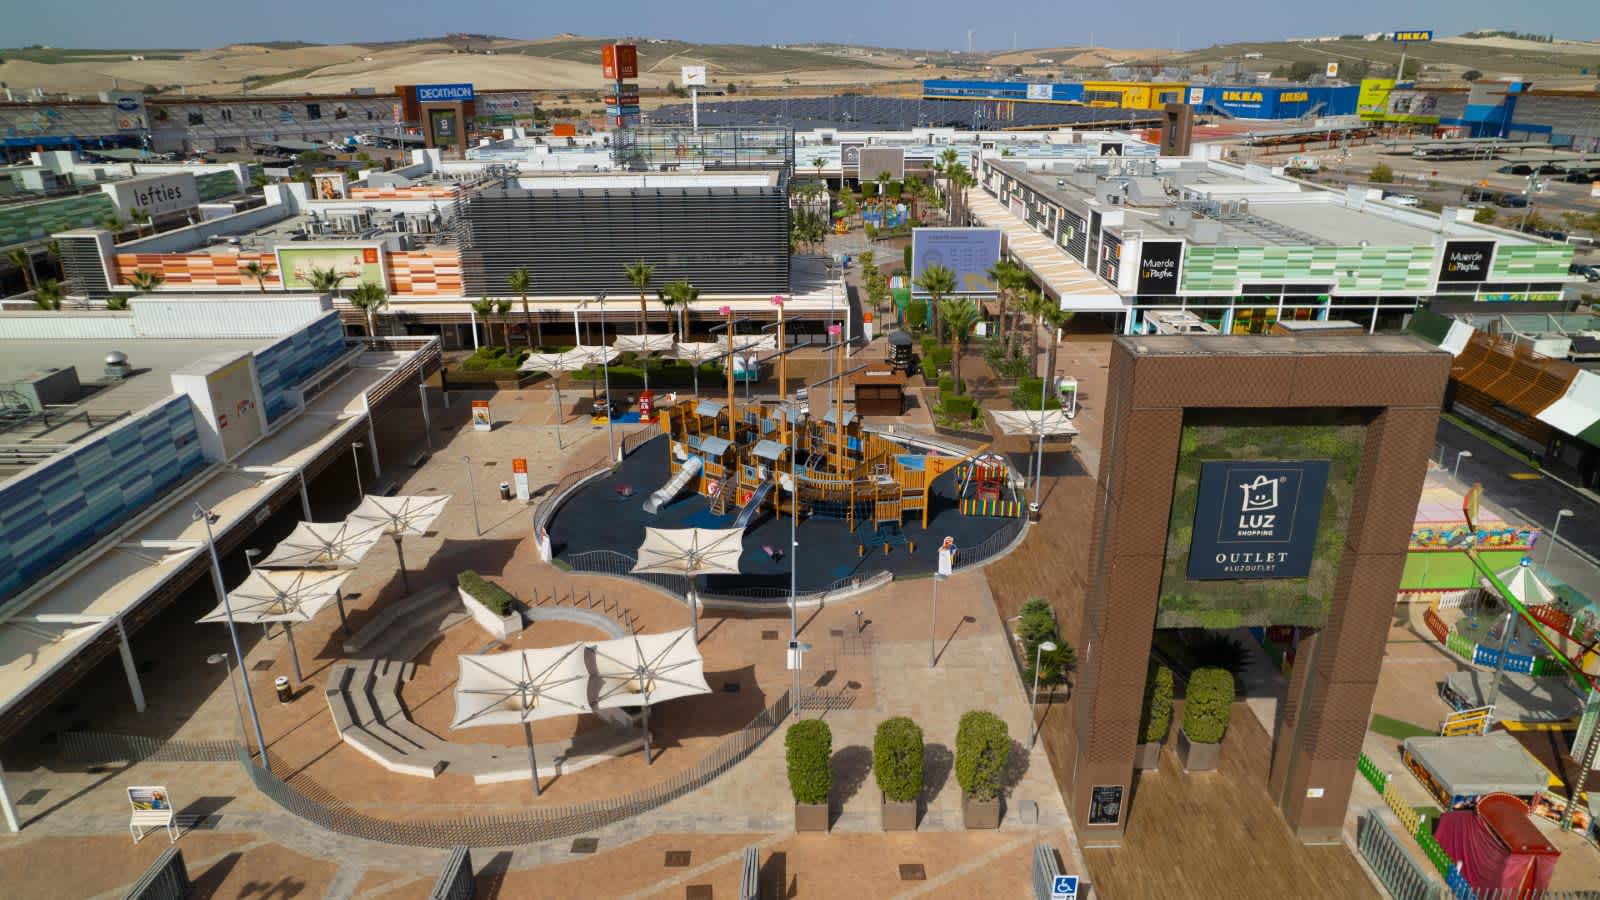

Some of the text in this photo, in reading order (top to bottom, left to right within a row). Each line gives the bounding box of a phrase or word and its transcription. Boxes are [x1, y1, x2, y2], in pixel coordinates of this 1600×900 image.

[1397, 32, 1429, 41] IKEA
[420, 87, 471, 99] DECATHLON
[1222, 91, 1263, 102] IKEA
[1280, 92, 1308, 102] IKEA
[134, 184, 182, 206] lefties
[1450, 252, 1483, 261] Muerde
[1143, 258, 1175, 268] Muerde
[1239, 514, 1276, 529] LUZ
[1215, 552, 1288, 564] OUTLET
[1223, 564, 1277, 573] #LUZOUTLET
